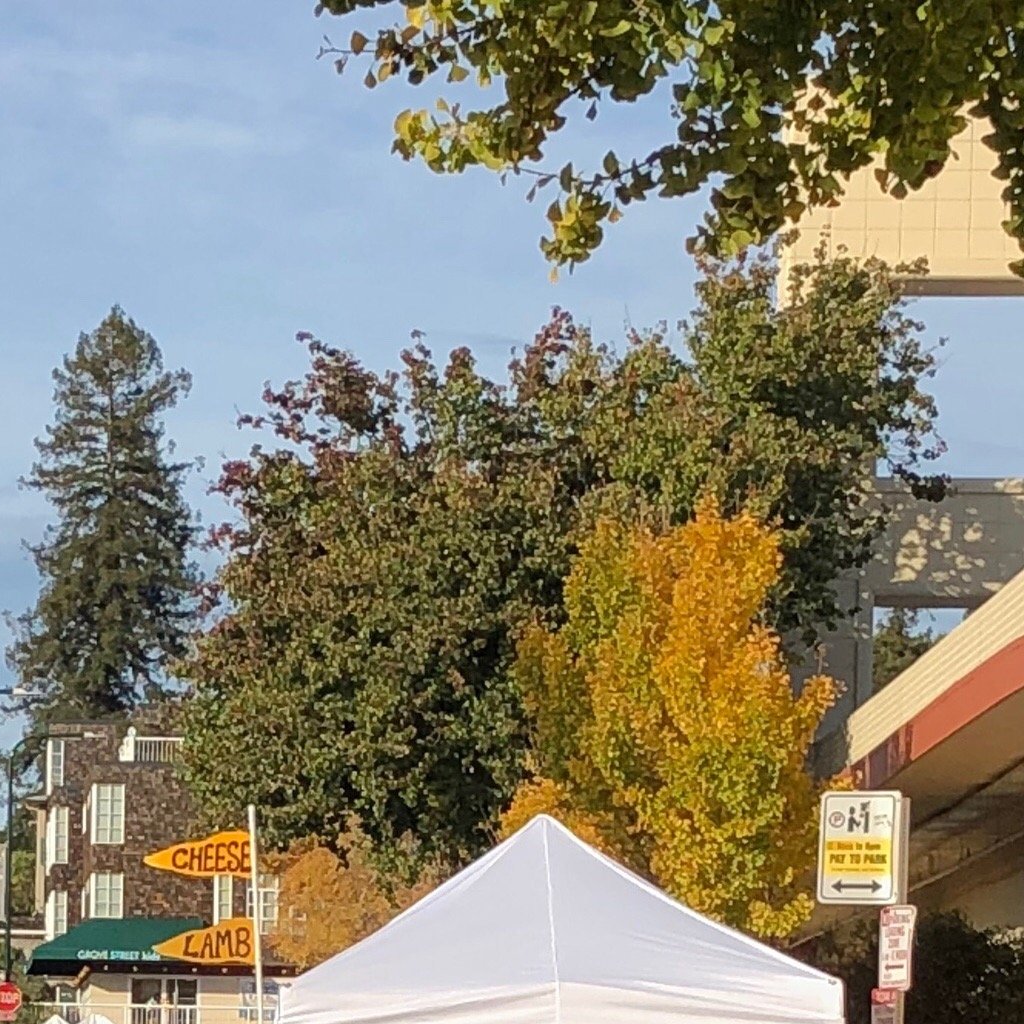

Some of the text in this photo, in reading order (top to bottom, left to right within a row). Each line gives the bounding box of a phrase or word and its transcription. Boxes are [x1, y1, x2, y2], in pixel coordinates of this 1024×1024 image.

[172, 841, 252, 873] CHEESE
[849, 853, 862, 865] TO
[183, 927, 251, 959] LAMB
[110, 950, 141, 960] STREET
